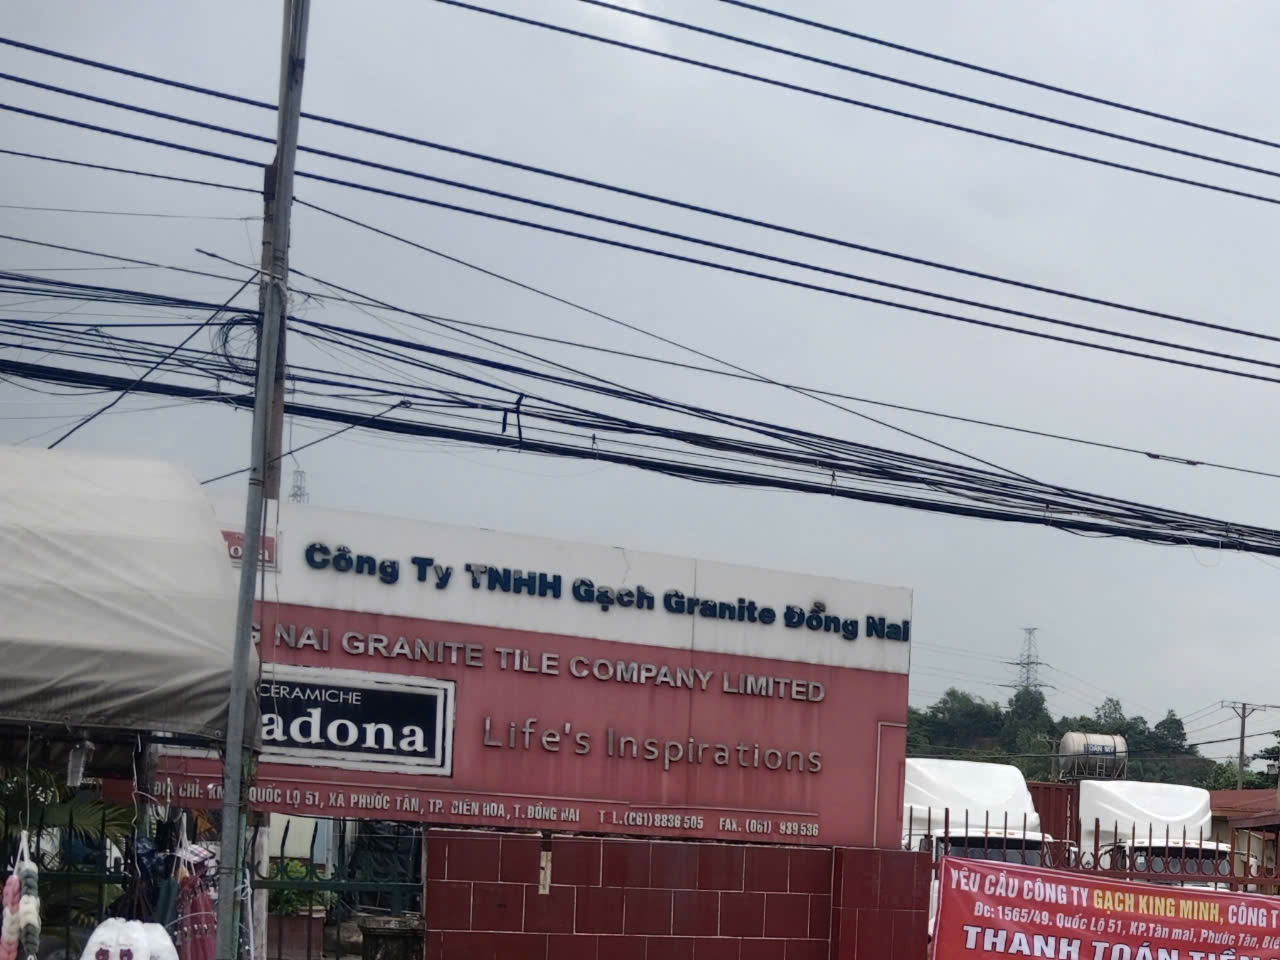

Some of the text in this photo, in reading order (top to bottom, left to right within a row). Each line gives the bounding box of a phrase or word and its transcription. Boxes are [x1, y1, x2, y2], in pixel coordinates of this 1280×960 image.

[305, 542, 400, 584] Công
[411, 556, 453, 588] Ty
[465, 562, 562, 599] TNHH
[571, 577, 655, 612] Gạch
[663, 589, 776, 625] Granite
[784, 601, 859, 641] Đồng
[866, 615, 910, 642] Nai
[275, 623, 329, 651] NAI
[341, 631, 484, 667] GRANITE
[496, 648, 560, 676] TILE
[569, 654, 713, 691] COMPANY
[722, 673, 826, 702] LIMITED
[257, 682, 362, 705] CERAMICHE
[261, 706, 428, 753] adona
[483, 716, 823, 774] Life's Inspirations
[249, 783, 282, 804] QUỐC
[286, 789, 301, 809] LỘ
[305, 791, 324, 809] 51,
[328, 789, 346, 808] XÃ
[350, 791, 391, 811] PHƯỚC
[395, 794, 425, 815] TÂN,
[428, 799, 446, 814] TP.
[526, 801, 558, 821] ĐỒNG
[683, 815, 705, 830] 505
[719, 817, 742, 832] FAX.
[800, 822, 819, 837] 536
[950, 867, 981, 893] YÊU
[983, 870, 1020, 898] CẦU
[1023, 878, 1067, 905] CÔNG
[1070, 886, 1089, 908] TY
[1093, 889, 1135, 916] GẠCH
[1139, 895, 1176, 919] KING
[1179, 898, 1224, 925] MINH,
[1227, 901, 1267, 929] CÔNG
[973, 902, 996, 919] Đc:
[996, 905, 1053, 926] 1565/49.
[1056, 912, 1088, 931] Quốc
[1089, 917, 1106, 935] Lộ
[1108, 919, 1126, 937] 51,
[1199, 927, 1235, 947] Phước
[1238, 932, 1260, 950] Tân,
